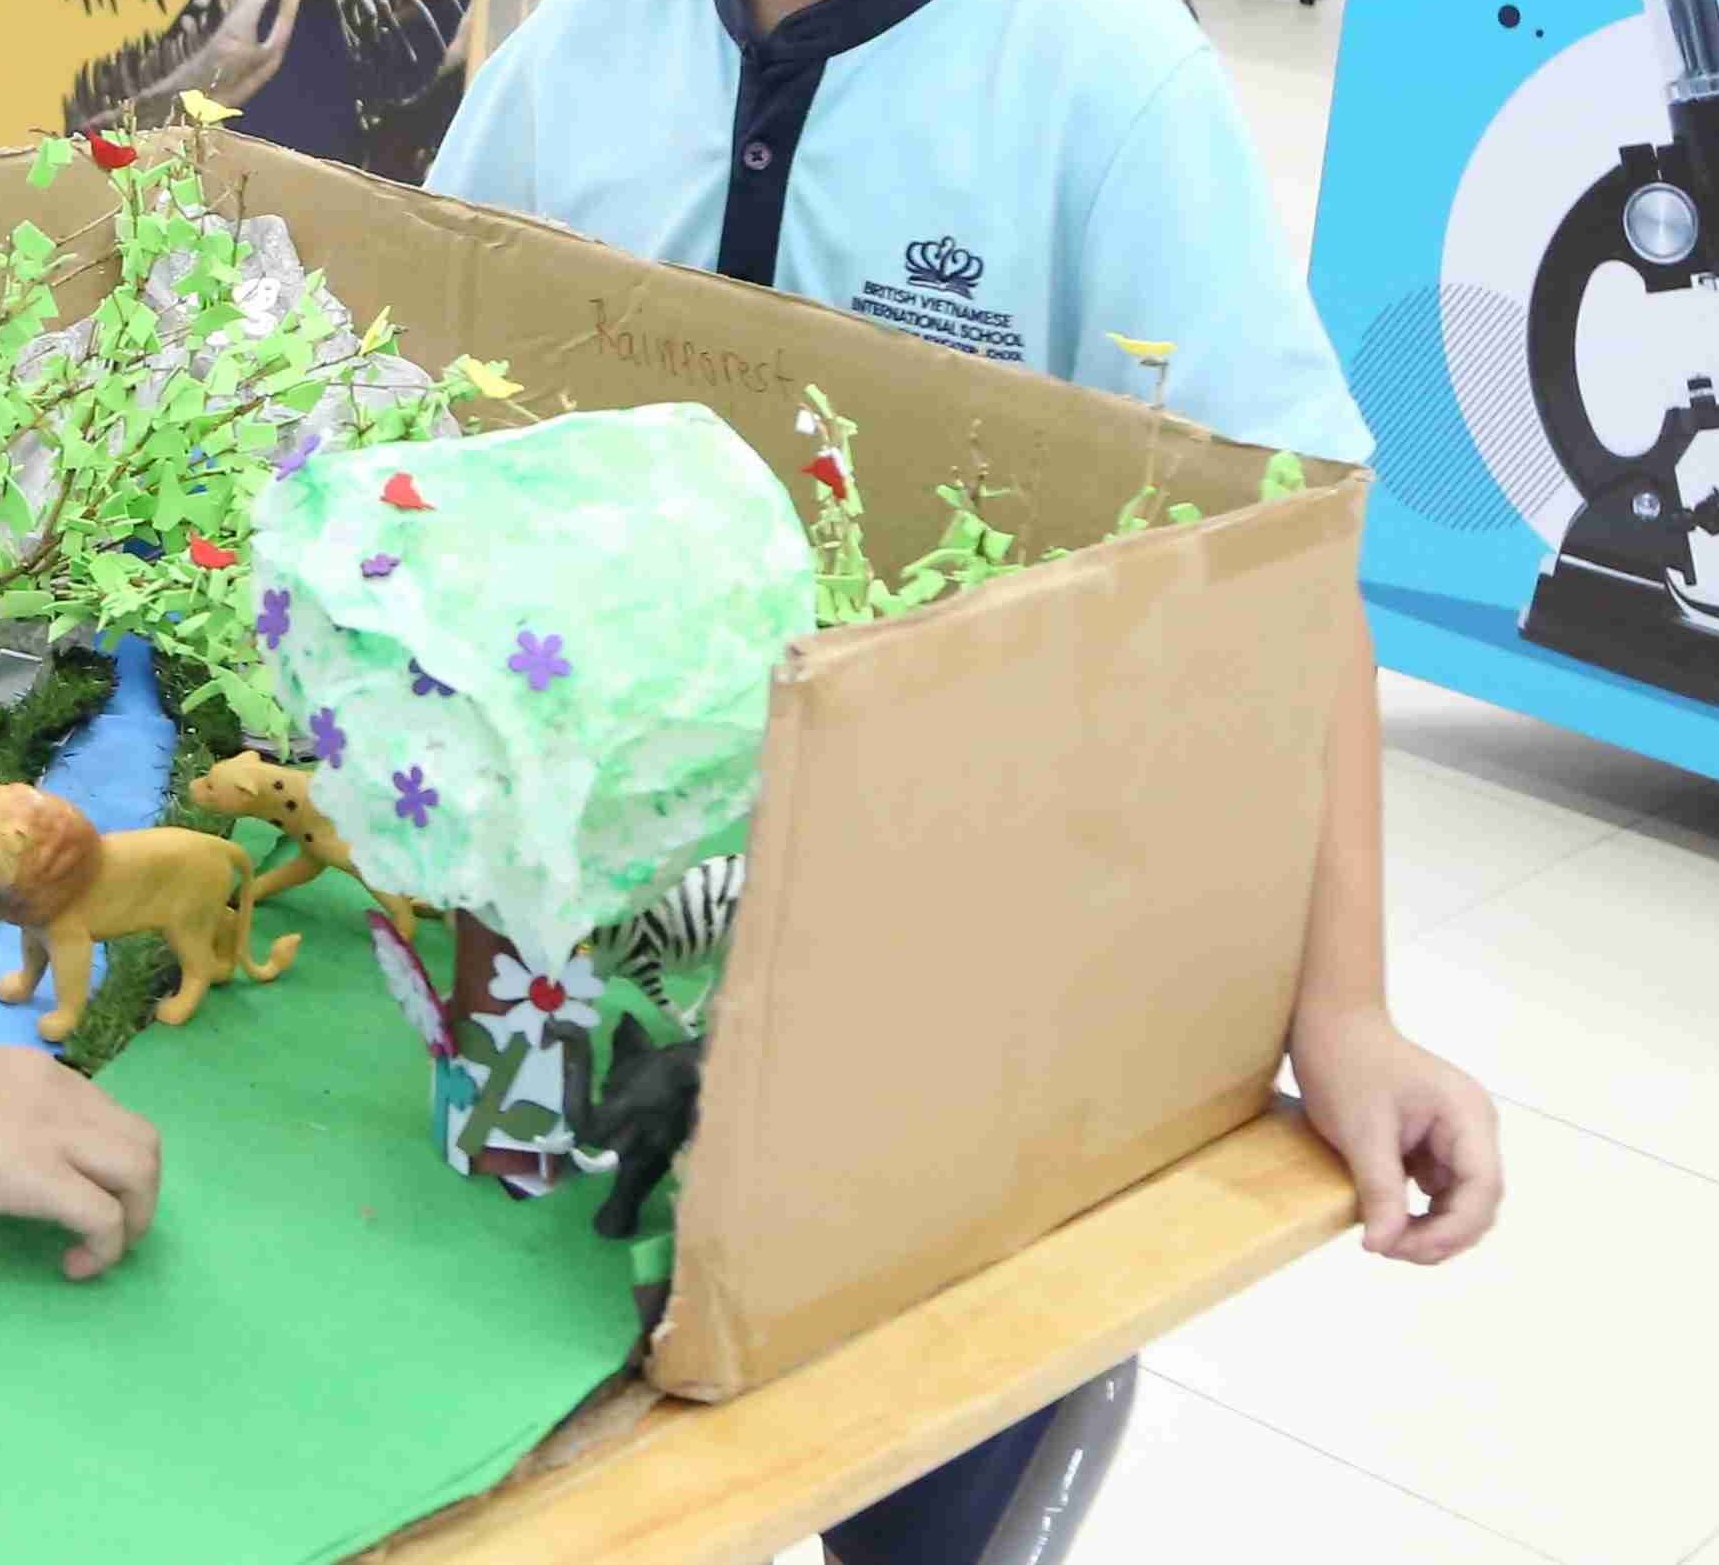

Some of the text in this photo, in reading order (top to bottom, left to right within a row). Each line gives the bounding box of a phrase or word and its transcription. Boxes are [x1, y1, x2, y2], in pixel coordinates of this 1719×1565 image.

[851, 296, 1025, 348] INTERNATIONAL SCHOOL
[863, 280, 1014, 328] BRITISH VIETNAMESE
